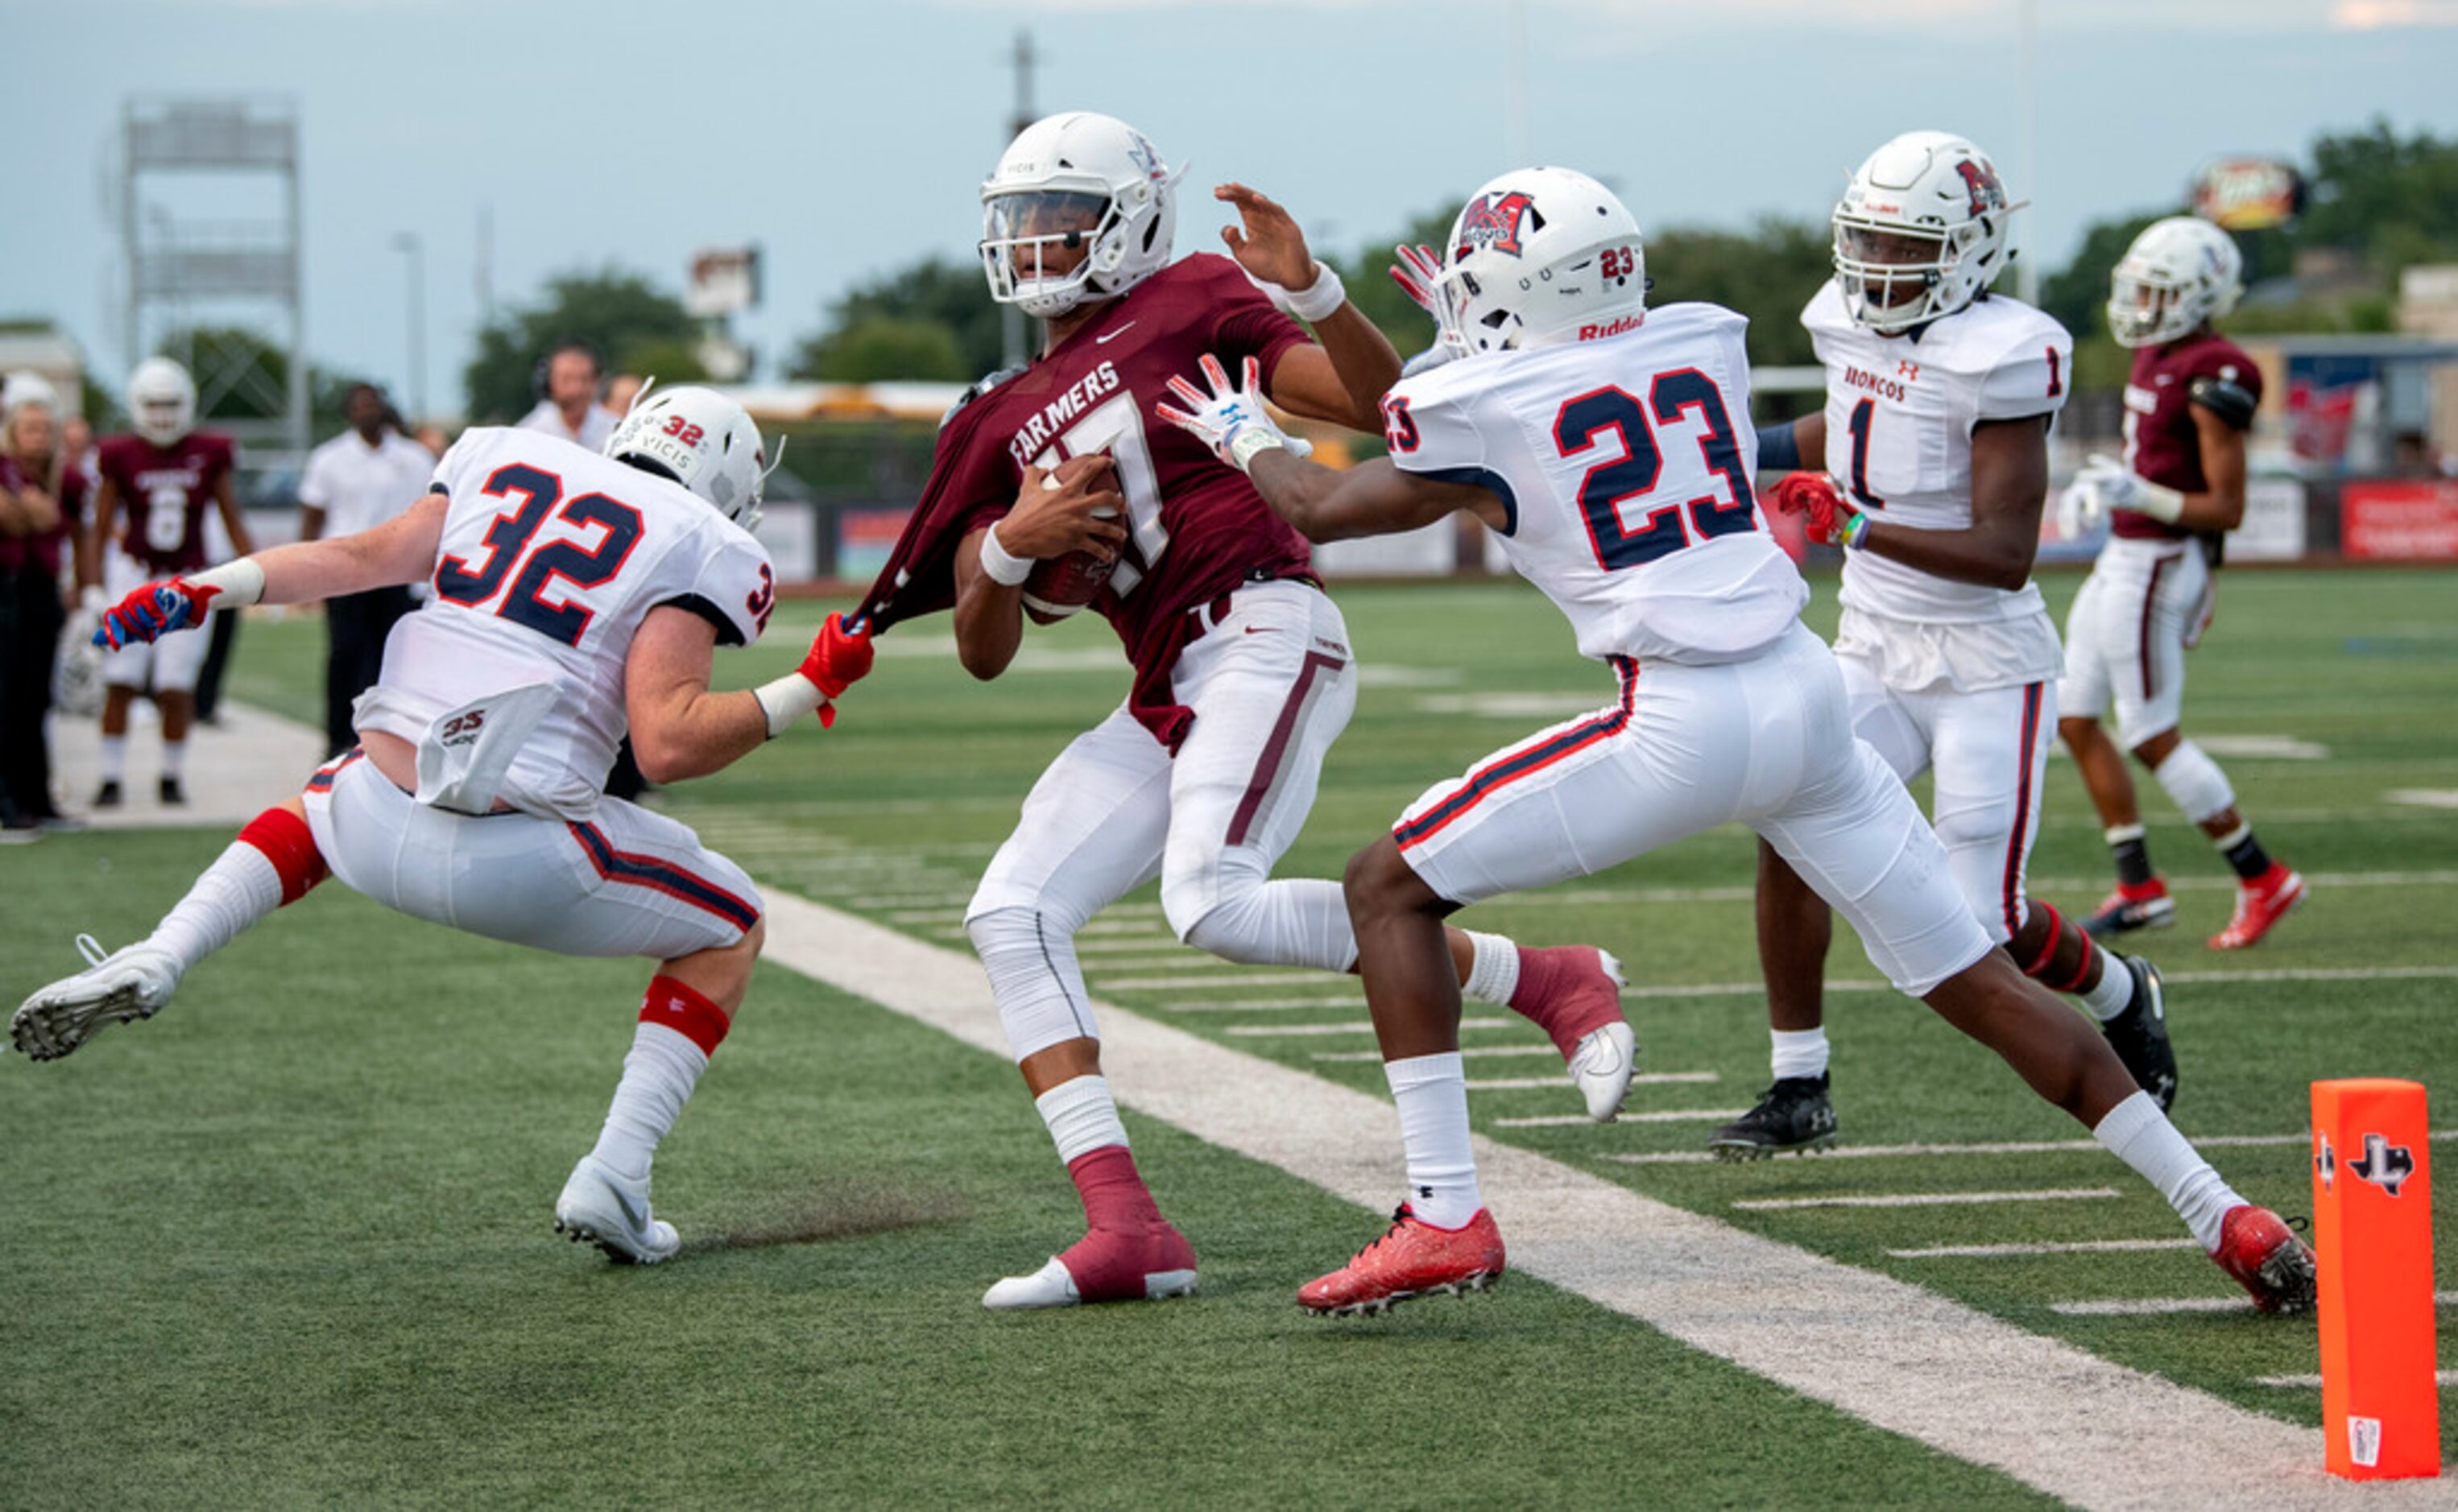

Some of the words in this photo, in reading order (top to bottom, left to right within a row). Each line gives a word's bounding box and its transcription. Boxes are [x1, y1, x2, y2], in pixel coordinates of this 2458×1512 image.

[1599, 245, 1634, 279] 23
[1008, 360, 1120, 473] FARMERS
[2046, 345, 2063, 399] 1
[662, 414, 705, 448] 32
[1552, 366, 1758, 572] 23
[1848, 397, 1885, 510] 1
[435, 462, 644, 648] 32
